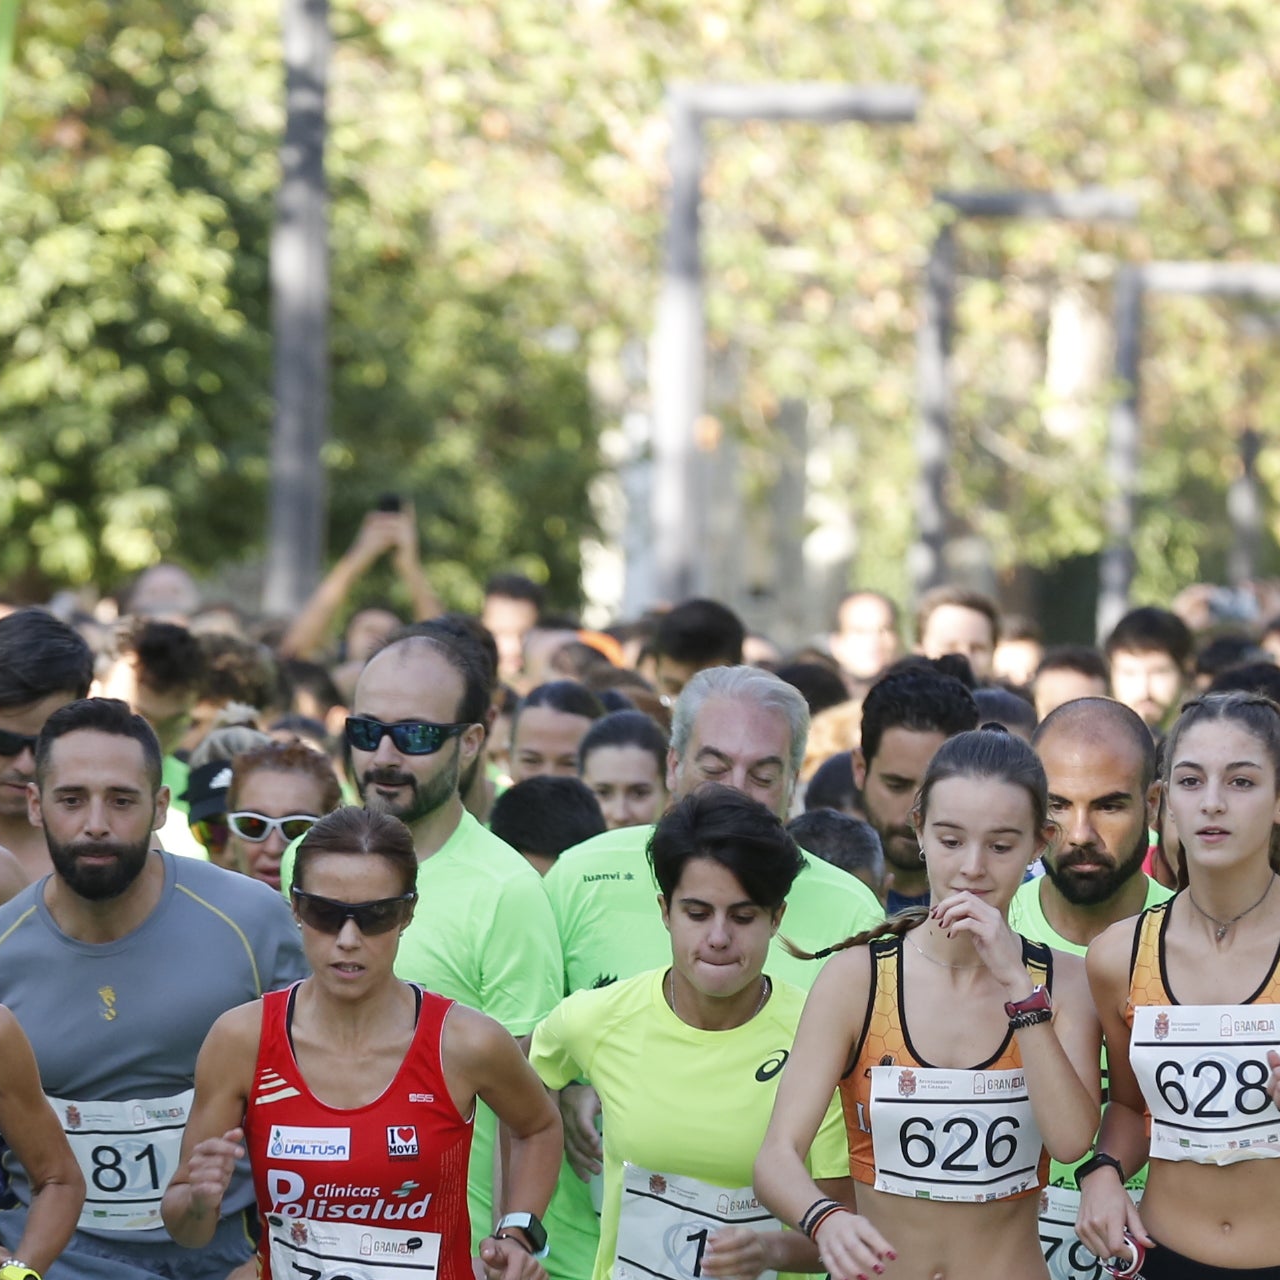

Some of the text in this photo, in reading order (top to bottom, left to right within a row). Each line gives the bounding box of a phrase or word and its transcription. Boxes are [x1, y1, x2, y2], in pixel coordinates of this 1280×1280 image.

[1155, 1060, 1274, 1118] 628
[91, 1143, 159, 1192] 81
[899, 1115, 1020, 1171] 626
[267, 1169, 432, 1220] Polisalud
[313, 1183, 380, 1198] Clínicas
[686, 1229, 708, 1278] 1
